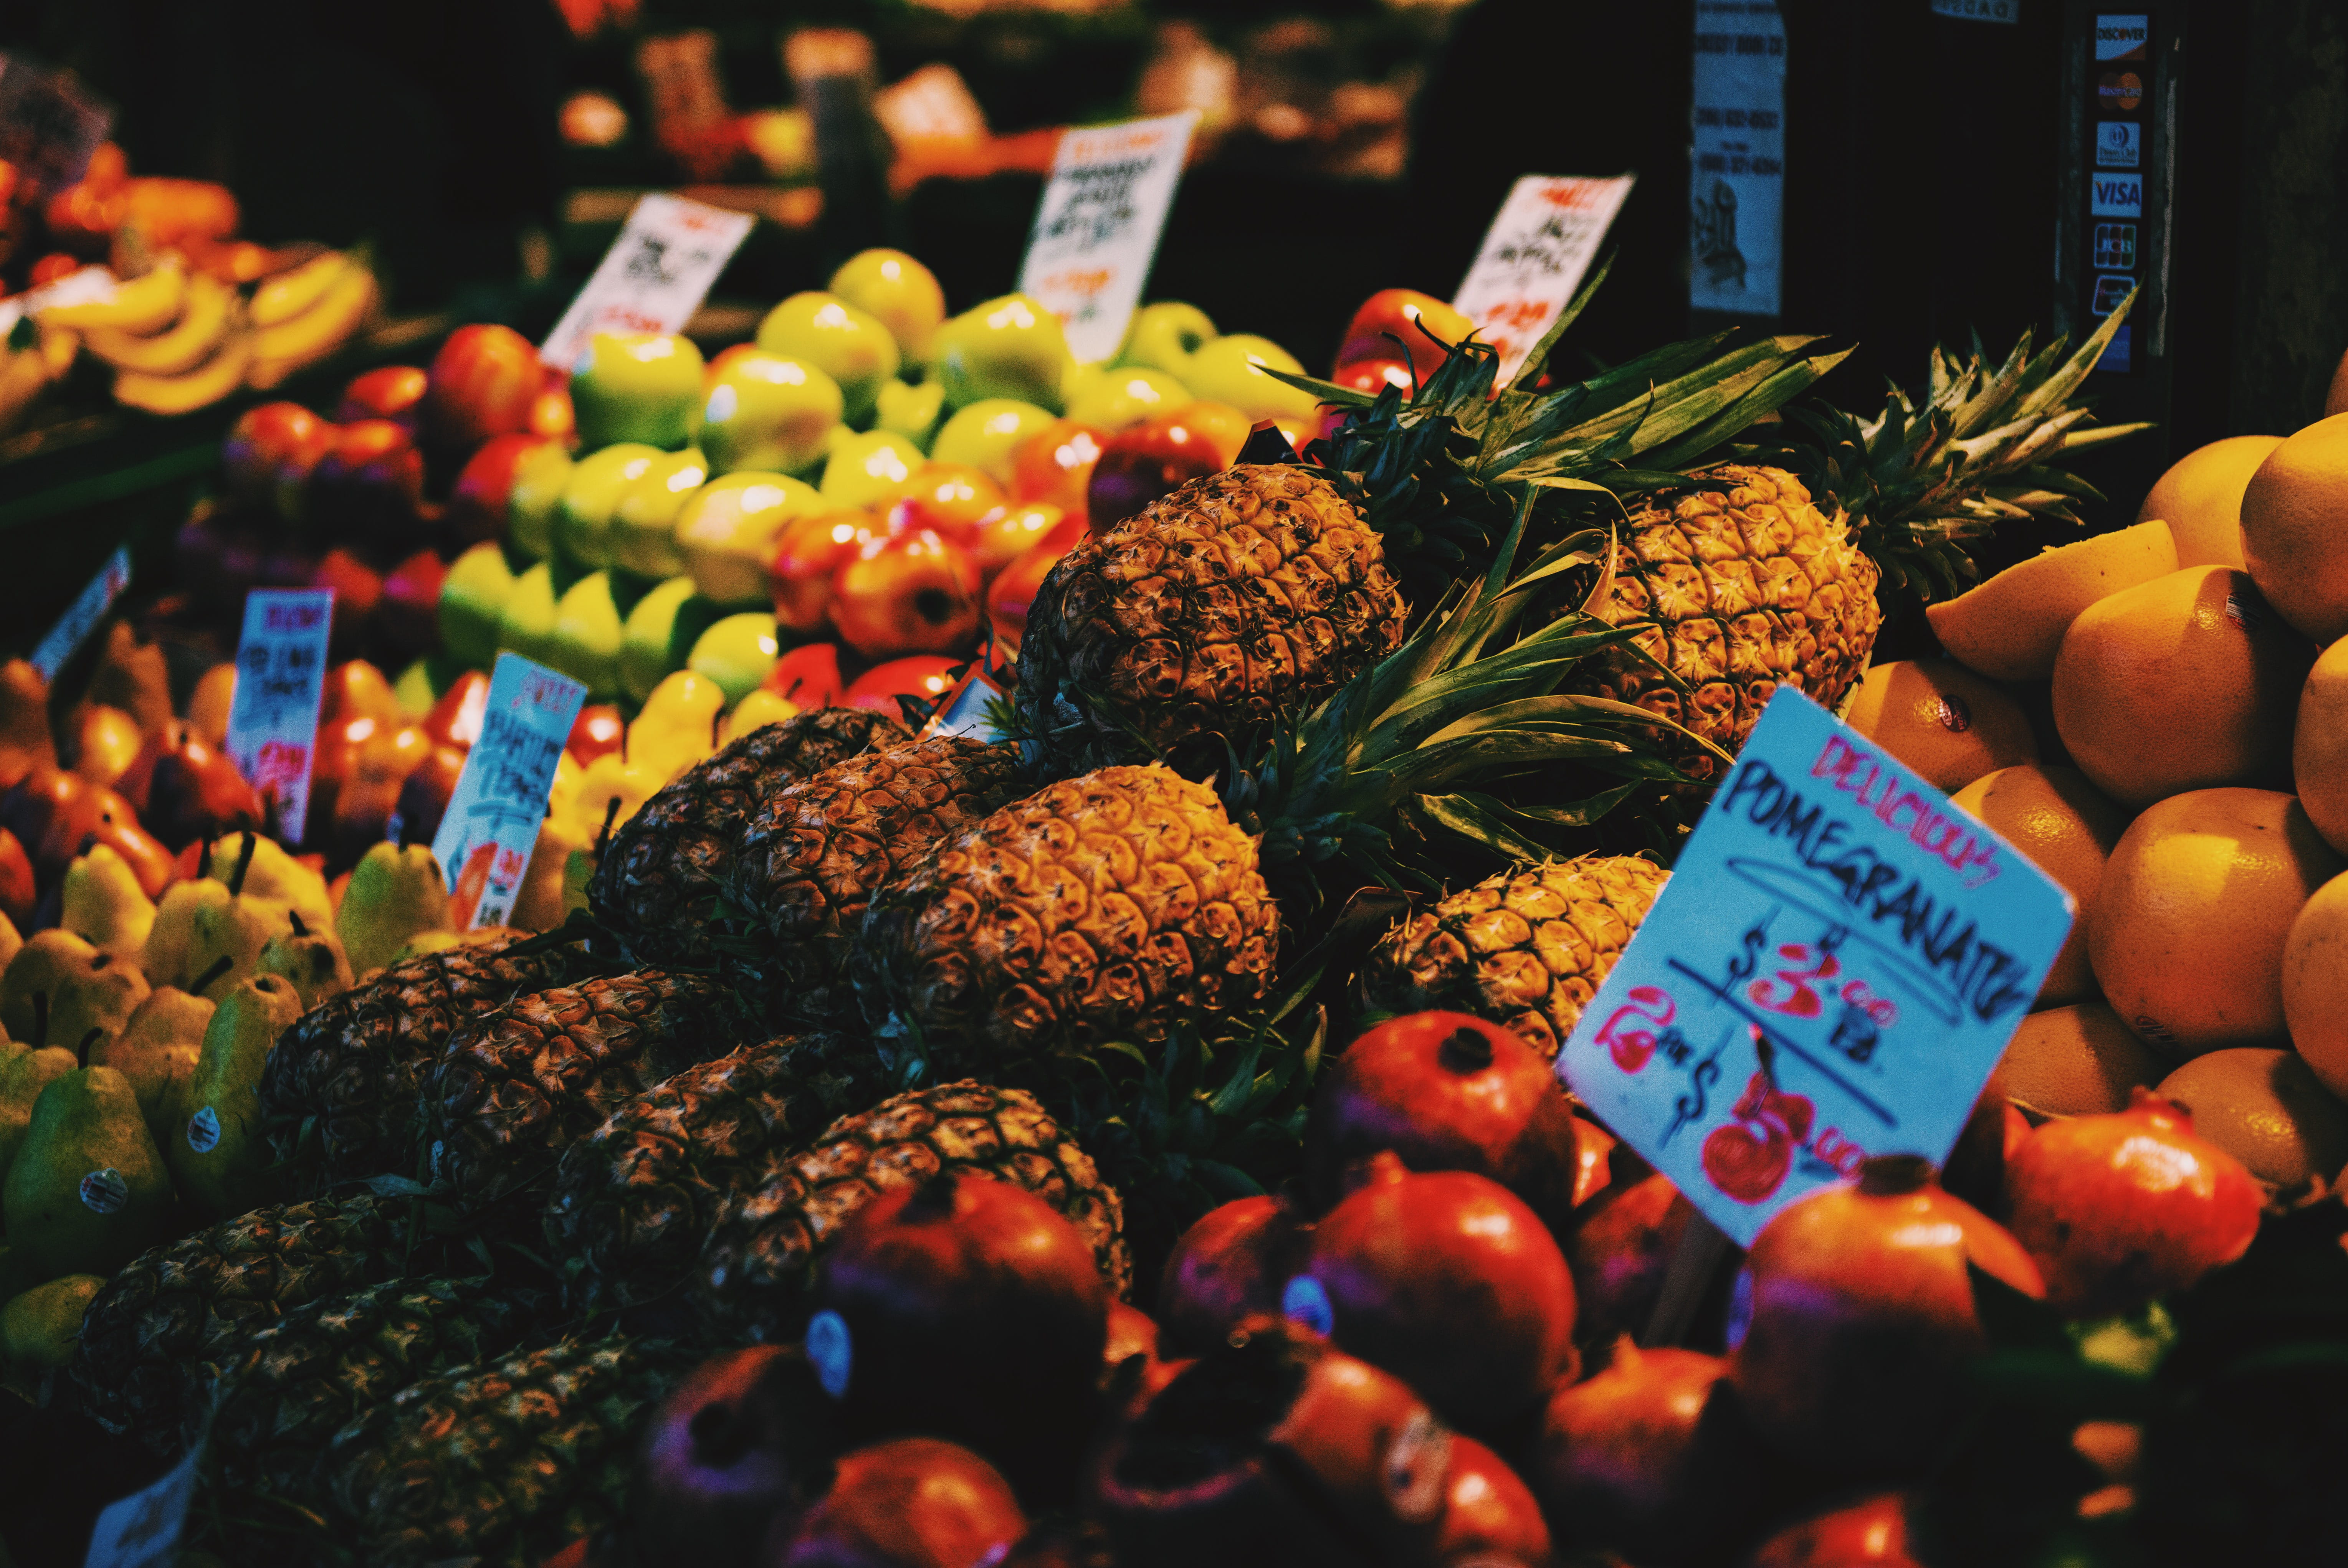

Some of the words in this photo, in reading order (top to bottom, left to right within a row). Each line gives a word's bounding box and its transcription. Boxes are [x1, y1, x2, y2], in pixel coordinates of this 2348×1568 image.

[2097, 27, 2145, 40] DISCOVER
[2095, 181, 2140, 205] VISA
[1811, 734, 2002, 889] DELICIOUS
